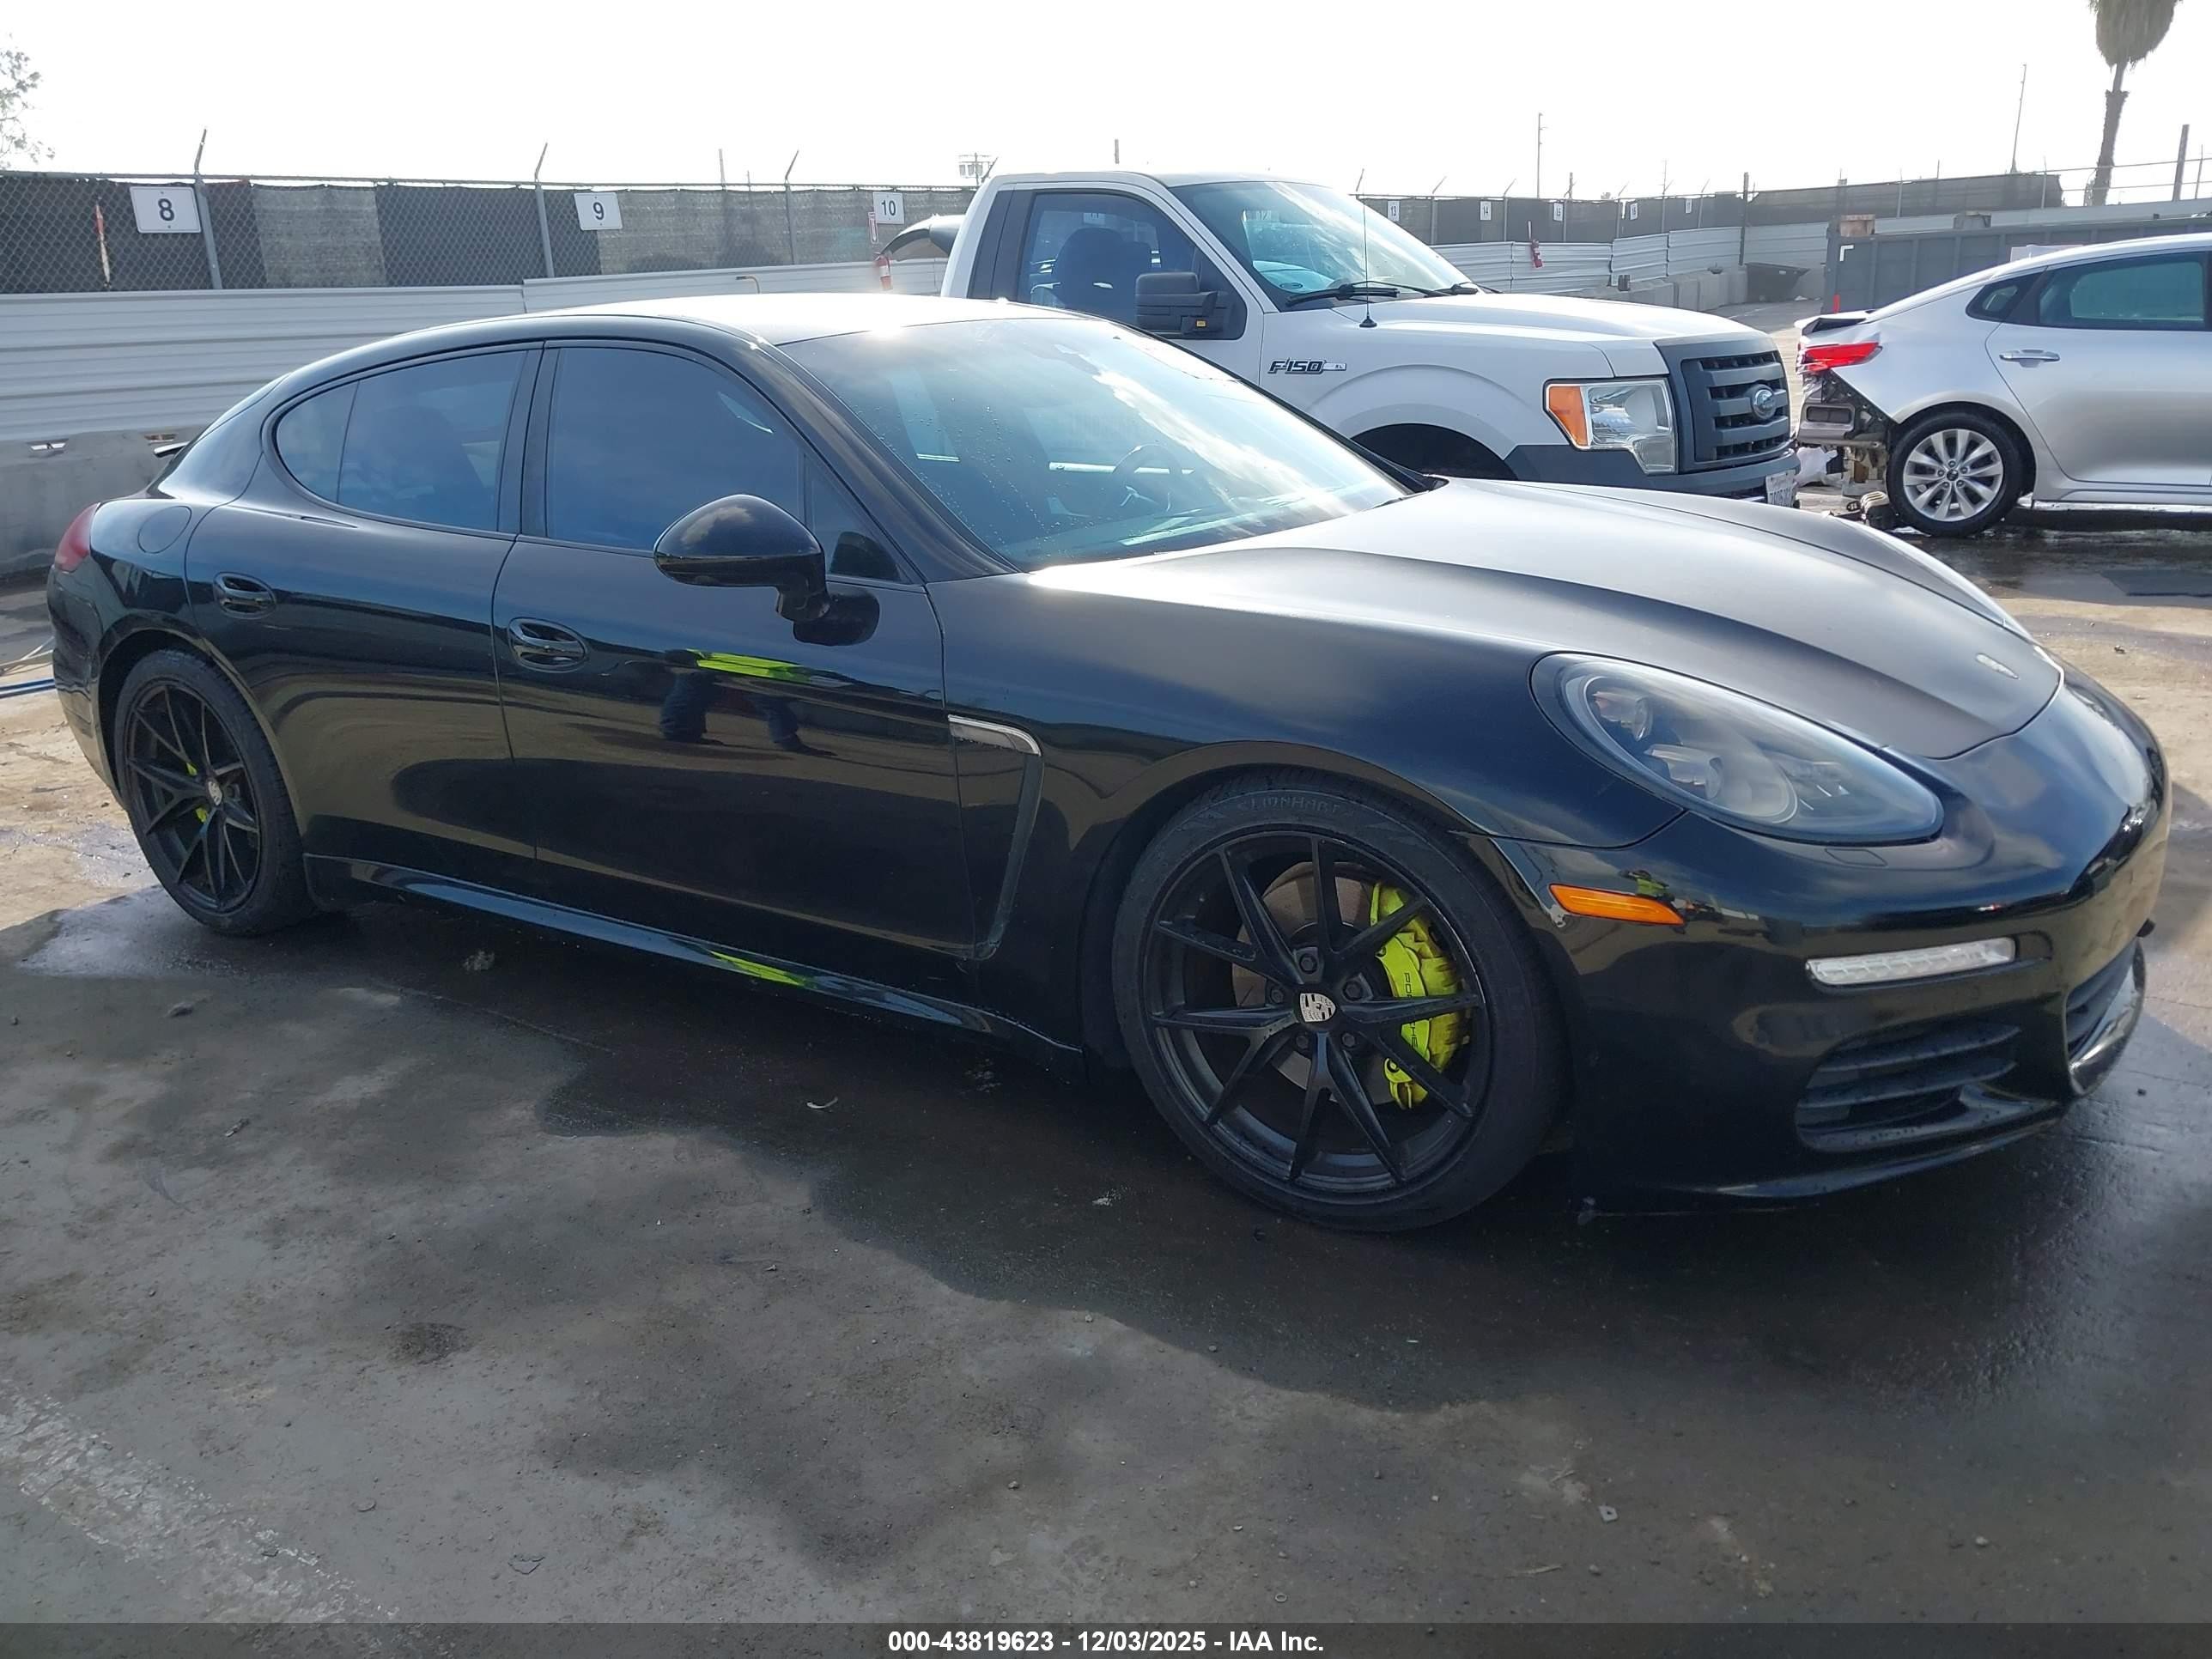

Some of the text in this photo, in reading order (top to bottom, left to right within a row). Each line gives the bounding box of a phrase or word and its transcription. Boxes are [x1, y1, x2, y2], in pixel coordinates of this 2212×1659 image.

[158, 198, 174, 221] 8
[593, 202, 605, 221] 9
[881, 199, 896, 216] 10
[1390, 205, 1397, 216] 13
[1482, 205, 1489, 216] 14
[1269, 360, 1323, 373] F-150
